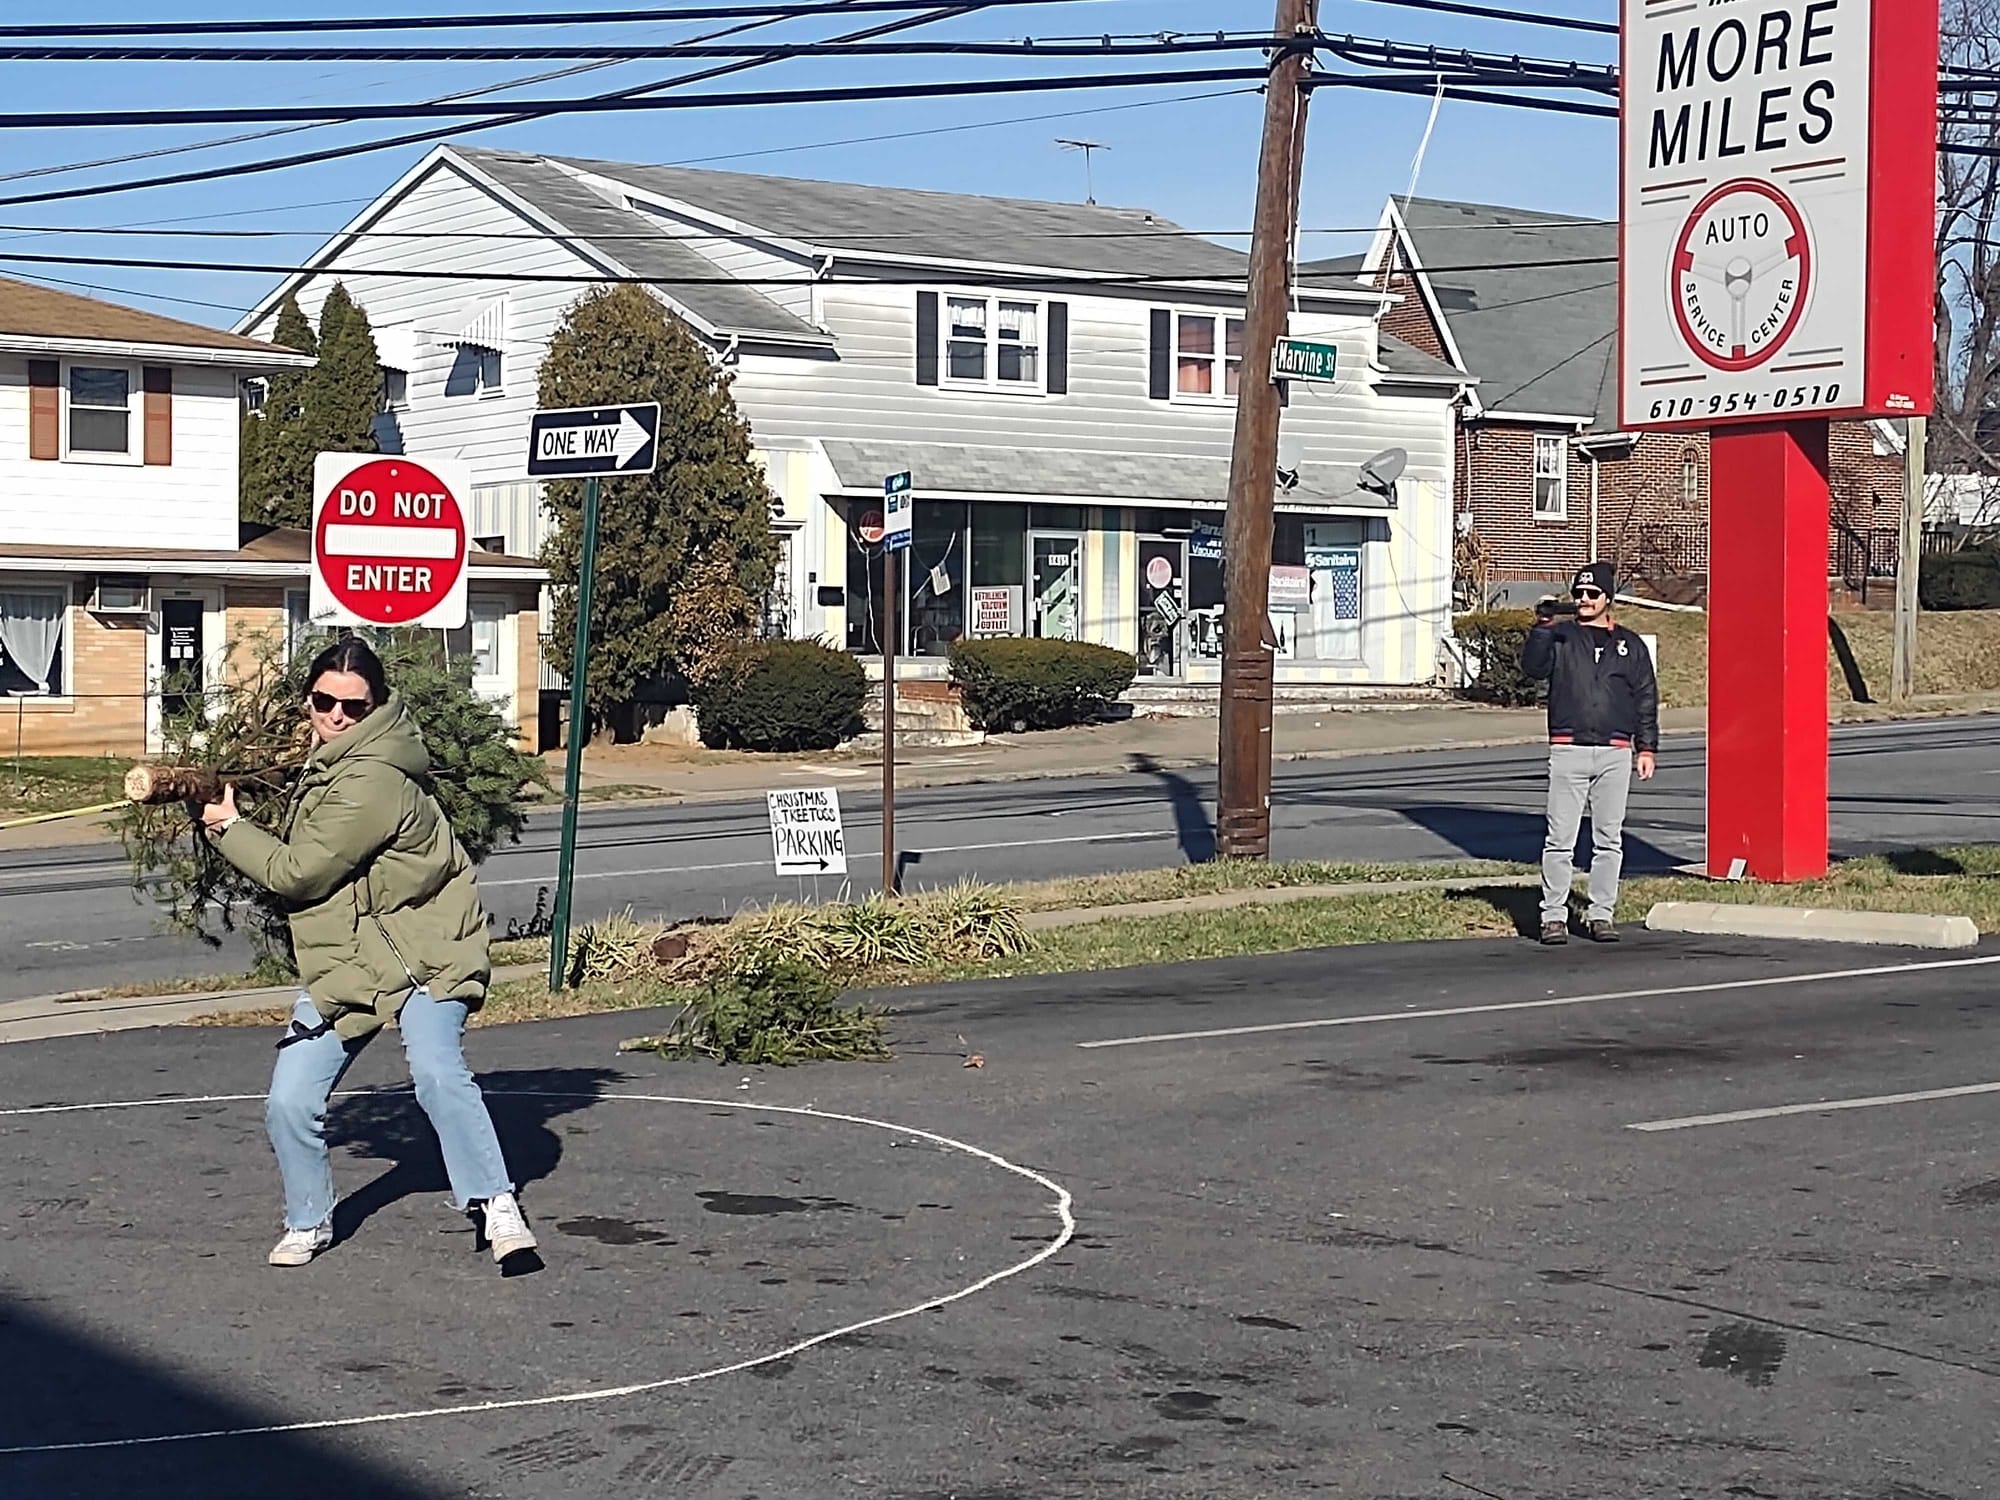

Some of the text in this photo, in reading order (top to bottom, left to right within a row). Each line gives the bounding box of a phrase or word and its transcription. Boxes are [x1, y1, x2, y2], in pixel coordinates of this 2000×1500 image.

[1656, 0, 1838, 93] MORE
[1648, 79, 1835, 169] MILES
[1705, 212, 1769, 245] AUTO
[1685, 282, 1726, 348] SERVICE
[1751, 279, 1793, 344] CENTER
[1649, 384, 1840, 419] 610-954-0510
[542, 428, 620, 456] ONE WAY
[339, 489, 446, 520] DO NOT
[347, 564, 432, 593] ENTER
[769, 791, 828, 809] CHRISTMAS
[775, 827, 844, 857] PARKING
